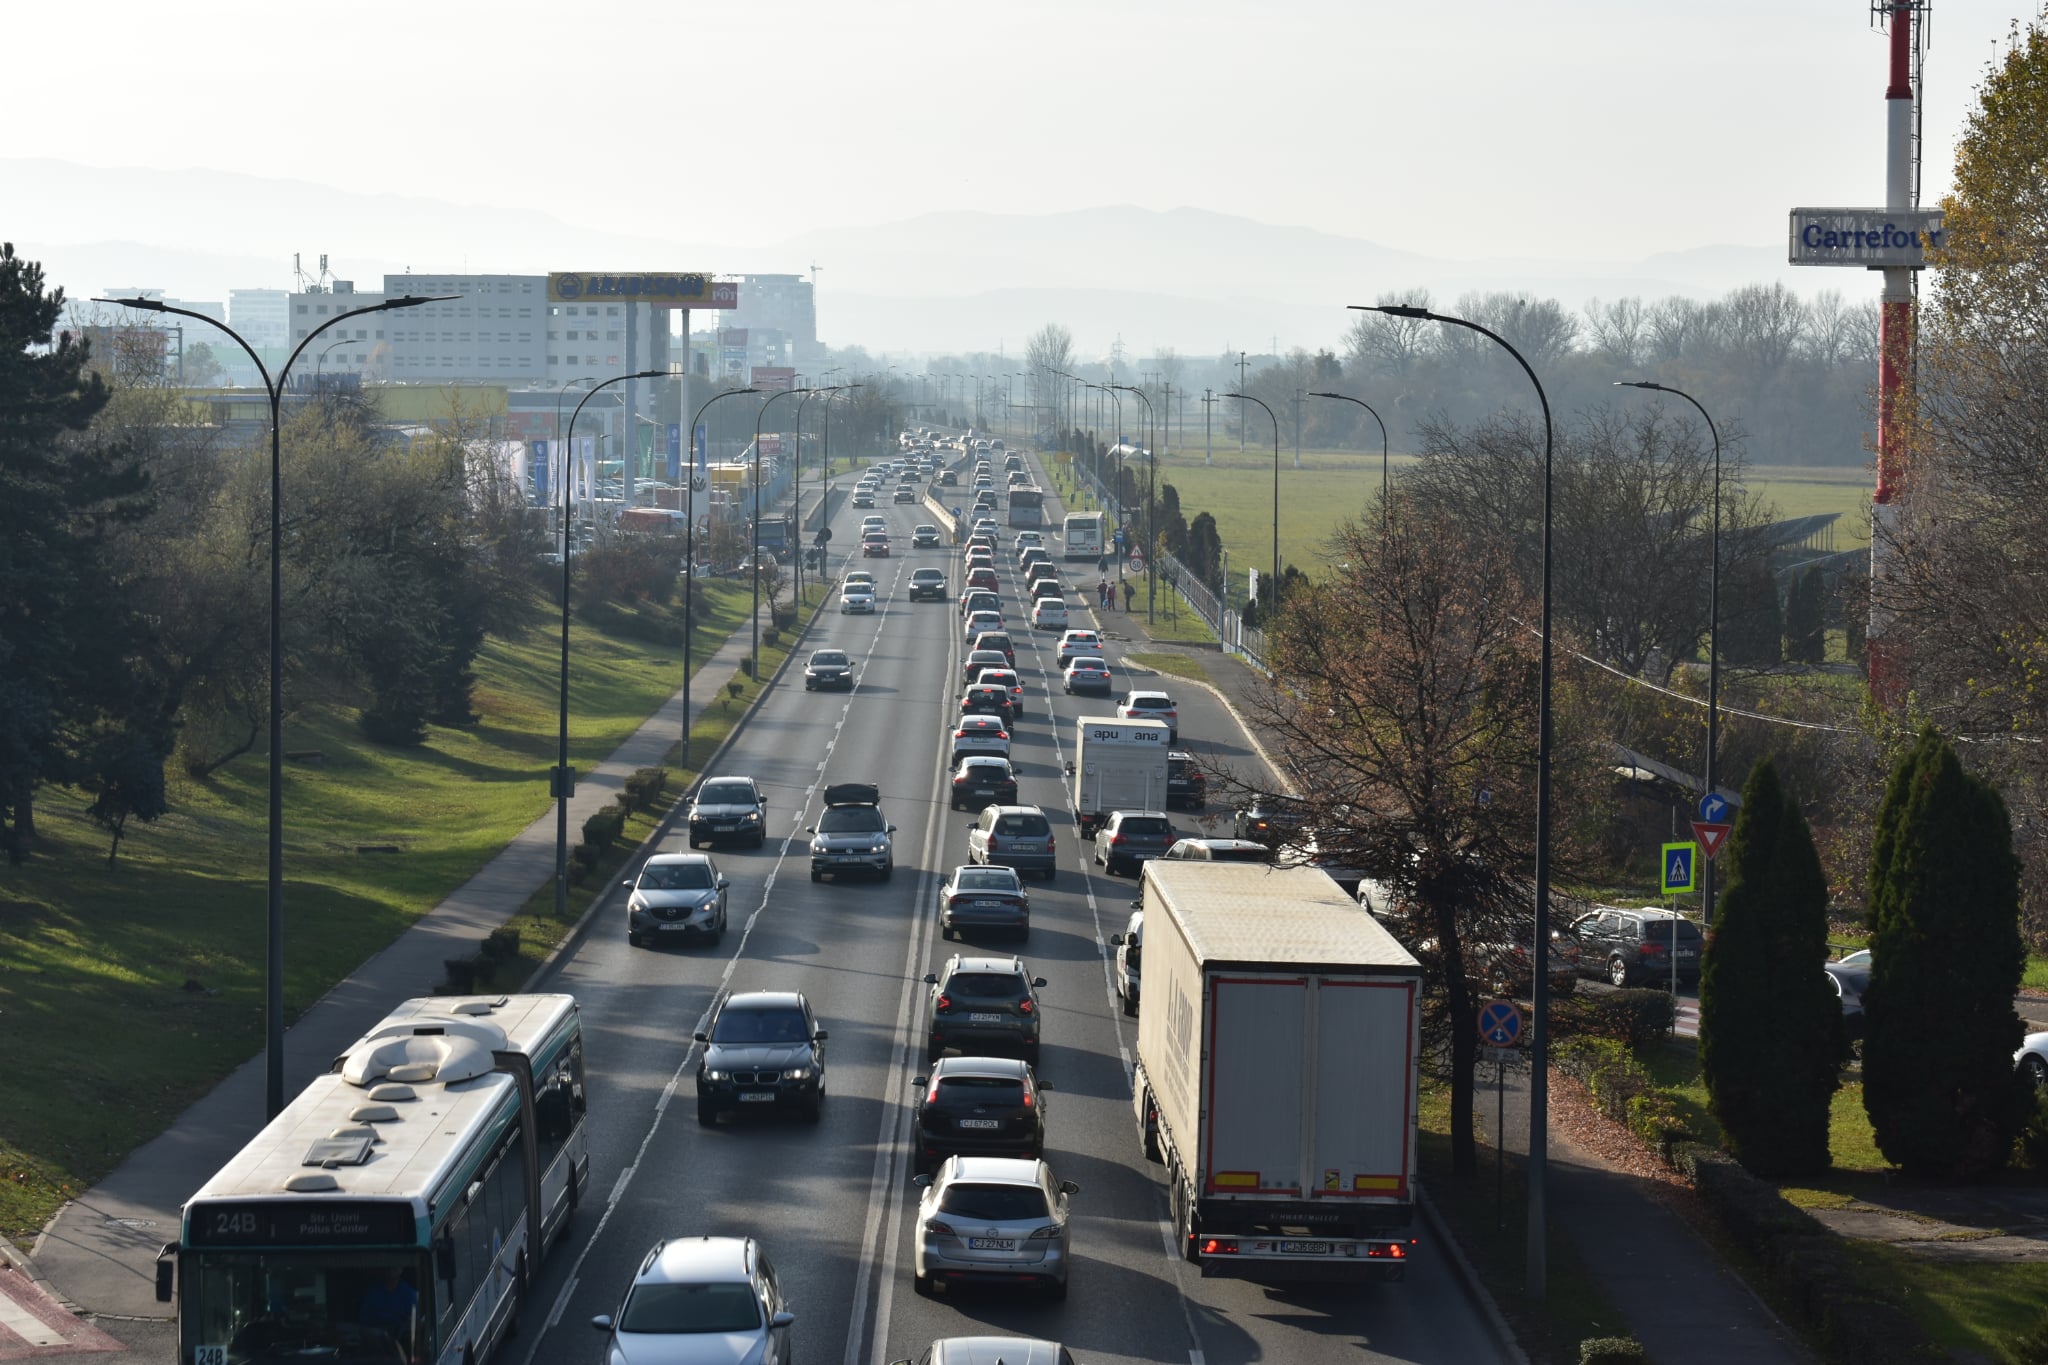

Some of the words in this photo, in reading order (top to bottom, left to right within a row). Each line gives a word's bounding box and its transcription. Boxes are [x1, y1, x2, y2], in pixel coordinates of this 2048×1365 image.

[1802, 223, 1942, 249] Carrefour
[1094, 730, 1119, 741] apu
[1134, 732, 1158, 741] ana
[216, 1212, 257, 1234] 24B
[300, 1223, 330, 1234] Polus
[334, 1223, 369, 1234] Center
[199, 1348, 224, 1365] 24B
